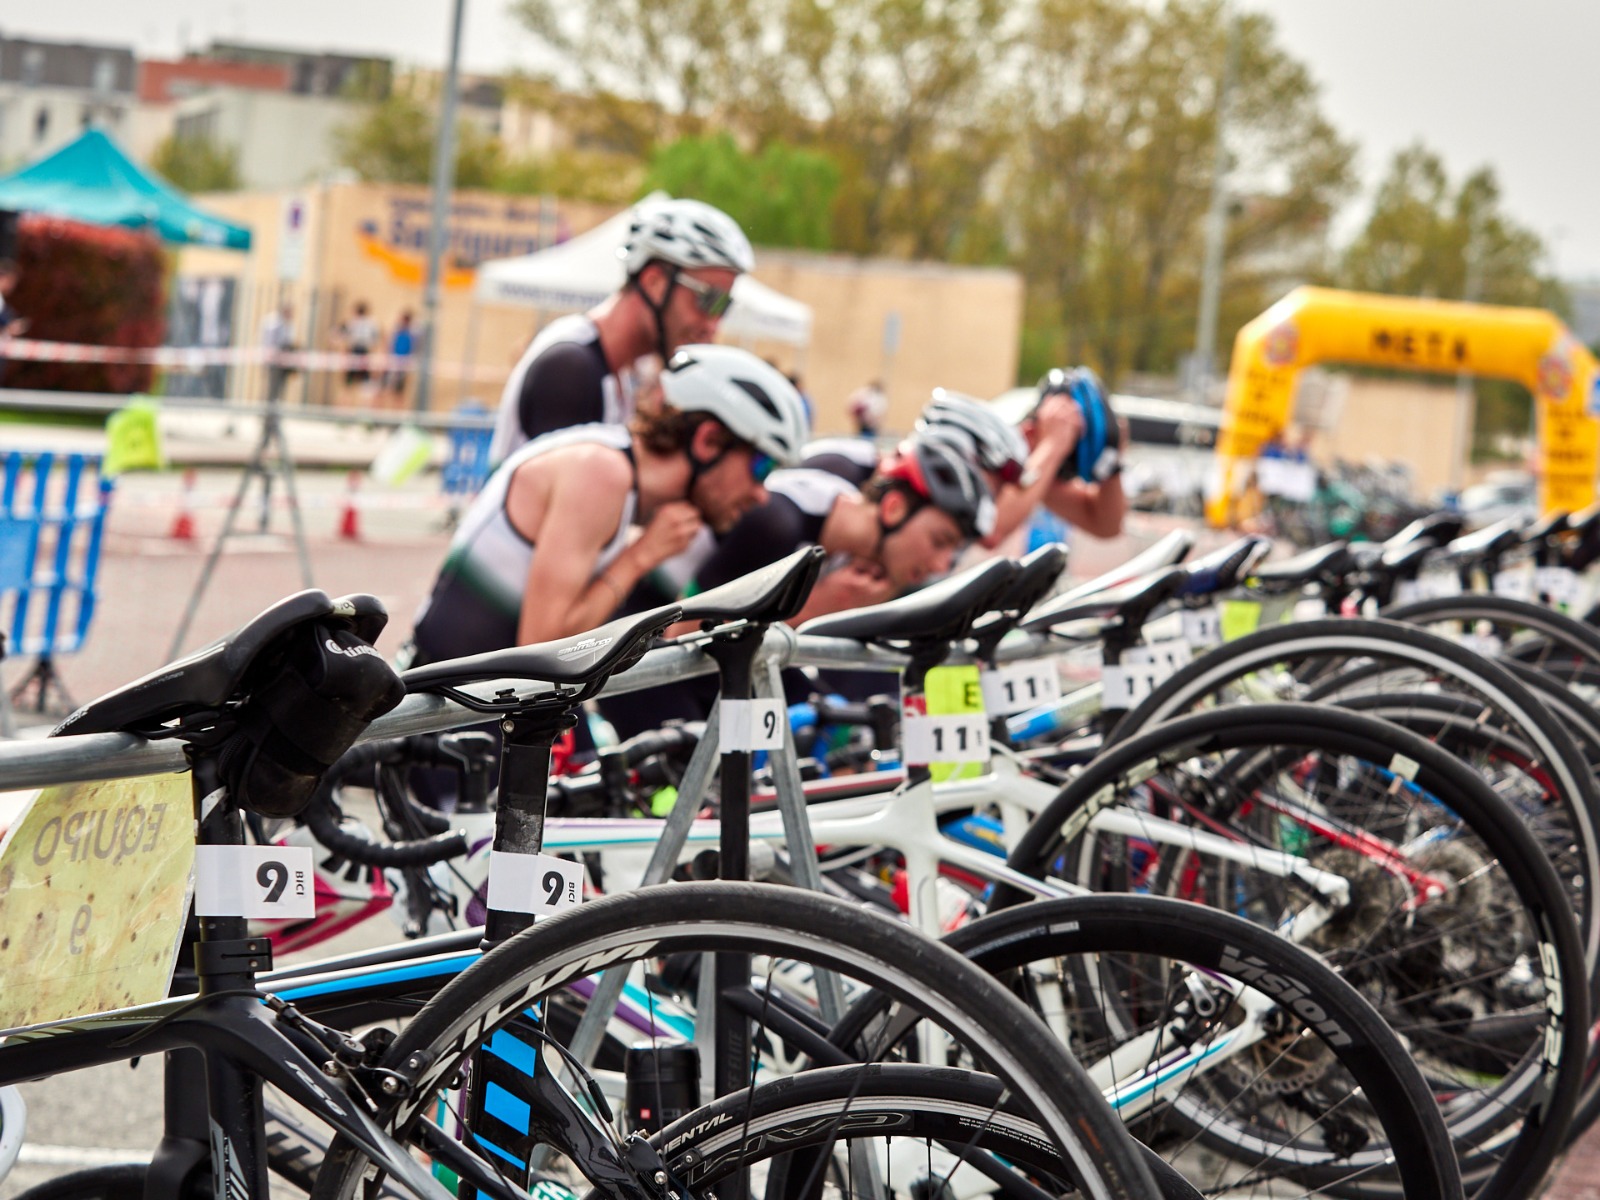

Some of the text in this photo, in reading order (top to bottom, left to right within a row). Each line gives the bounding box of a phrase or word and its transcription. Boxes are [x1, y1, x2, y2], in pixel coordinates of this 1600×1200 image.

[1370, 327, 1470, 362] META
[1003, 677, 1036, 702] 11
[764, 711, 775, 739] 9
[932, 727, 967, 752] 11
[256, 861, 289, 903] 9
[295, 871, 304, 895] BICI
[542, 871, 564, 906] 9
[1219, 945, 1352, 1047] Vision
